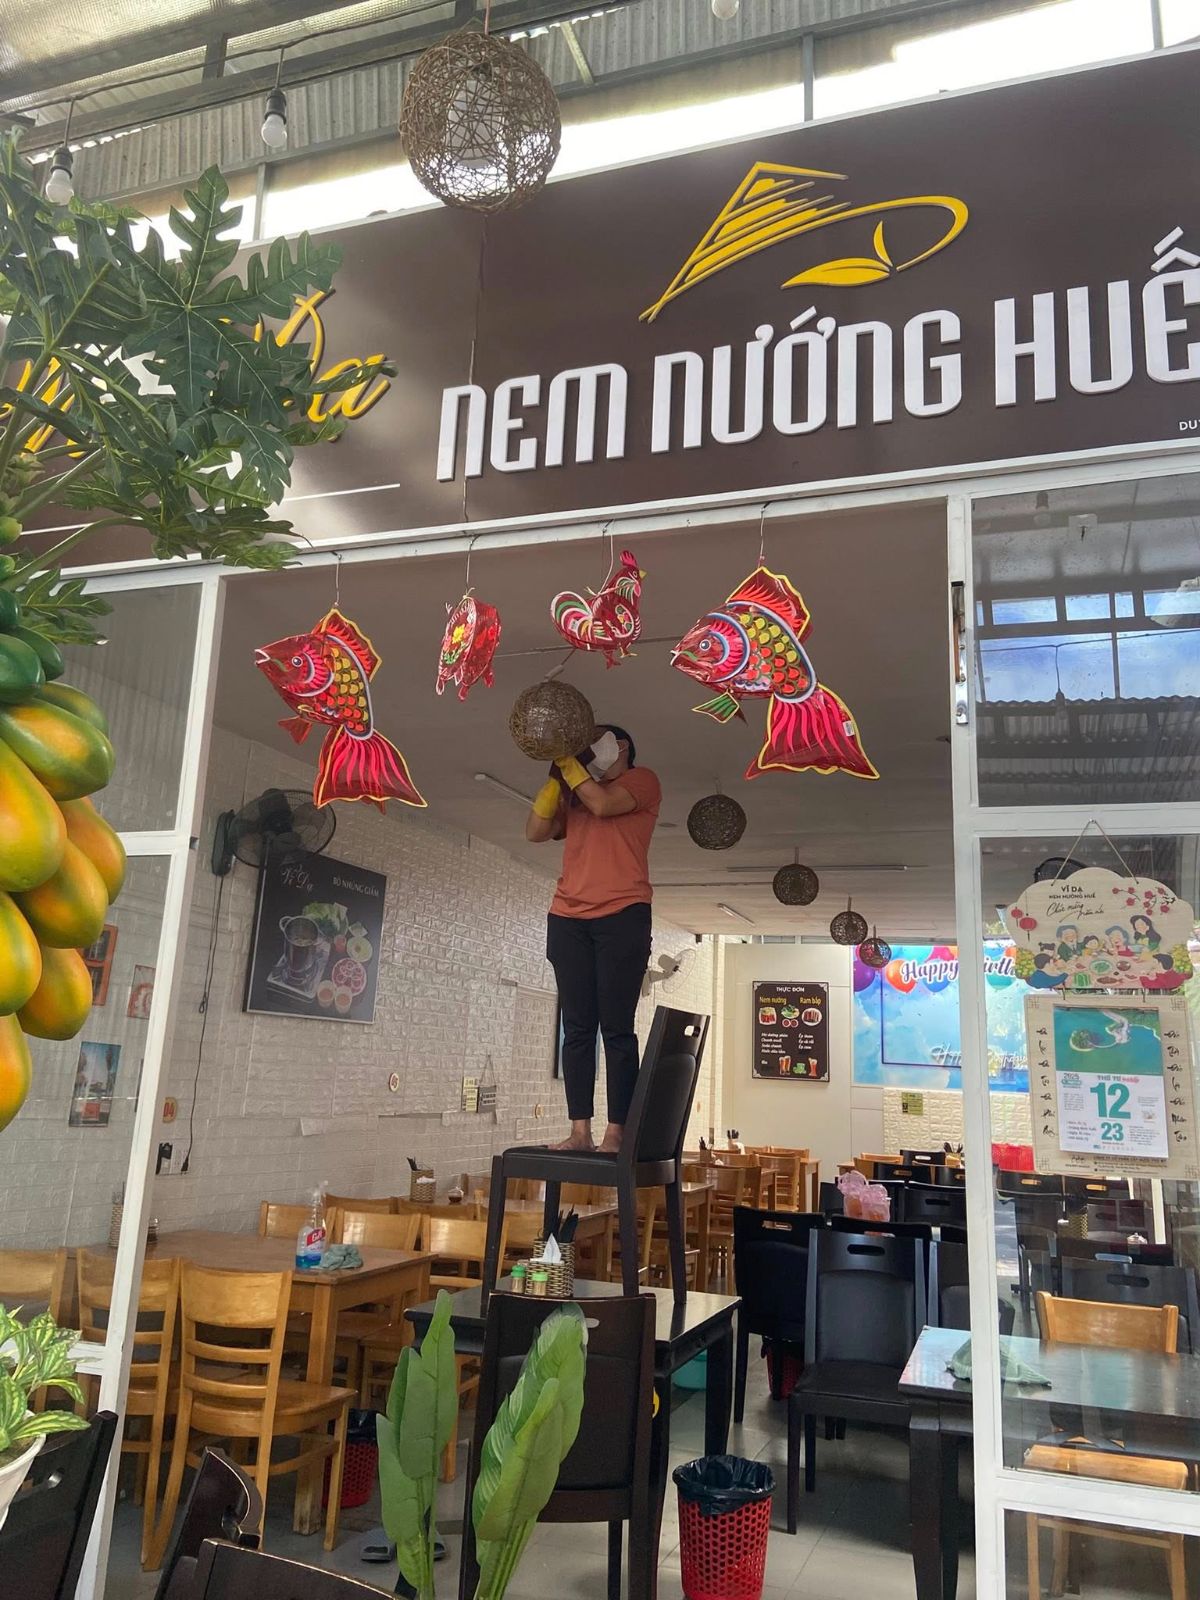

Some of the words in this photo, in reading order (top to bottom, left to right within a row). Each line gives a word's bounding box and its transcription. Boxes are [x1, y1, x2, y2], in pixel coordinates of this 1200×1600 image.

[436, 363, 628, 482] NEM
[651, 305, 963, 455] NƯỚNG
[994, 226, 1200, 409] HUẾ
[1179, 419, 1200, 431] DU
[900, 958, 960, 983] Happy
[799, 996, 811, 1005] Ram
[1090, 1082, 1132, 1119] 12
[1100, 1122, 1124, 1142] 23
